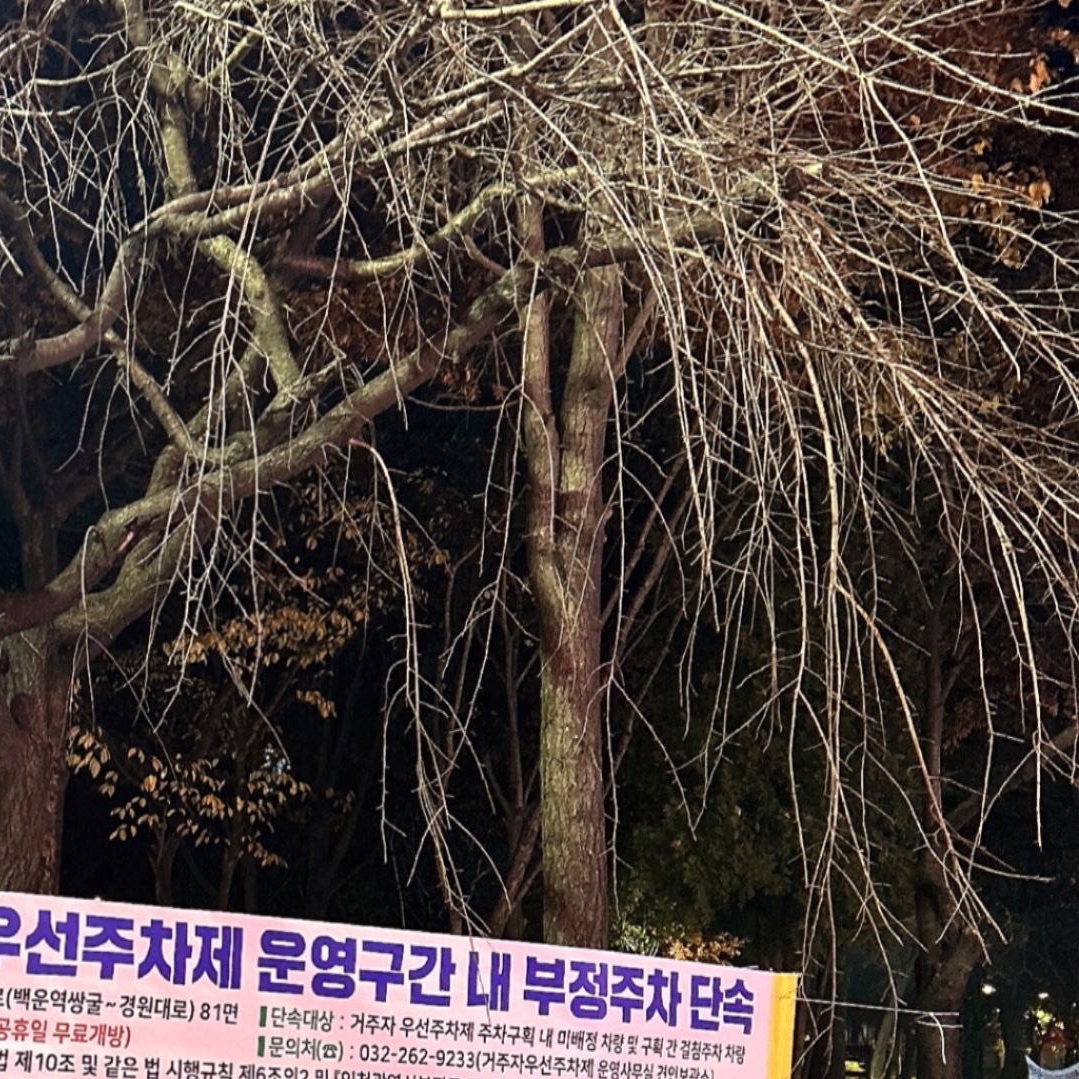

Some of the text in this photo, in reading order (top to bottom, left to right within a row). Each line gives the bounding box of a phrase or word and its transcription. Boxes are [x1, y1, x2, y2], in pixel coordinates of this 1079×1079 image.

[258, 929, 456, 1008] 운영구간
[467, 951, 511, 1012] 내
[523, 955, 682, 1027] 부정주차
[690, 974, 755, 1035] 단속
[199, 1002, 239, 1025] 81면
[53, 1022, 131, 1048] 무료개방)
[271, 1006, 335, 1032] 단속대상
[350, 1013, 396, 1037] 거주자
[400, 1017, 475, 1043] 우선주차제
[478, 1023, 535, 1047] 주차구획
[539, 1028, 553, 1049] 내
[558, 1029, 598, 1052] 미배정
[601, 1033, 624, 1055] 차량
[627, 1035, 639, 1055] 및
[641, 1037, 664, 1058] 구획
[666, 1039, 678, 1059] 간
[680, 1040, 723, 1063] 걸침주차
[724, 1044, 746, 1065] 차량
[15, 1050, 76, 1074] 제10조
[82, 1054, 98, 1077] 및
[104, 1055, 139, 1079] 같은
